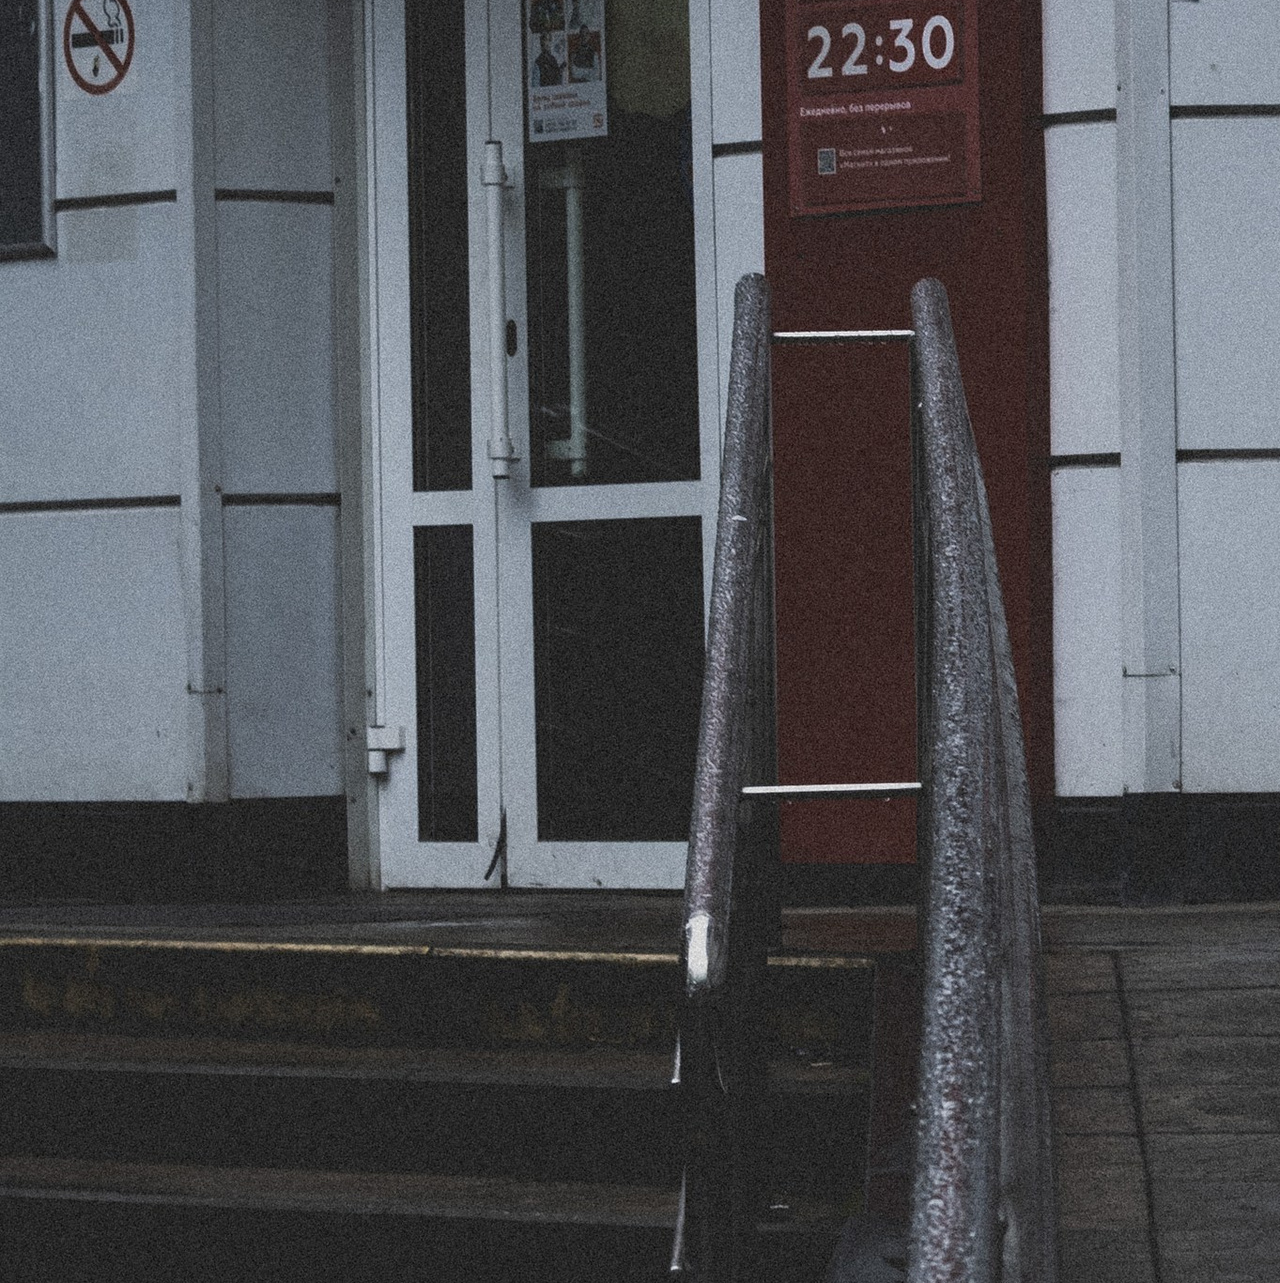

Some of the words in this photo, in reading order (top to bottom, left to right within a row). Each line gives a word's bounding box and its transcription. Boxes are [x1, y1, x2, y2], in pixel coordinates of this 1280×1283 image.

[806, 15, 956, 79] 22:30
[800, 105, 848, 117] Ежедневно,
[849, 103, 864, 113] без
[865, 101, 912, 114] перерывов
